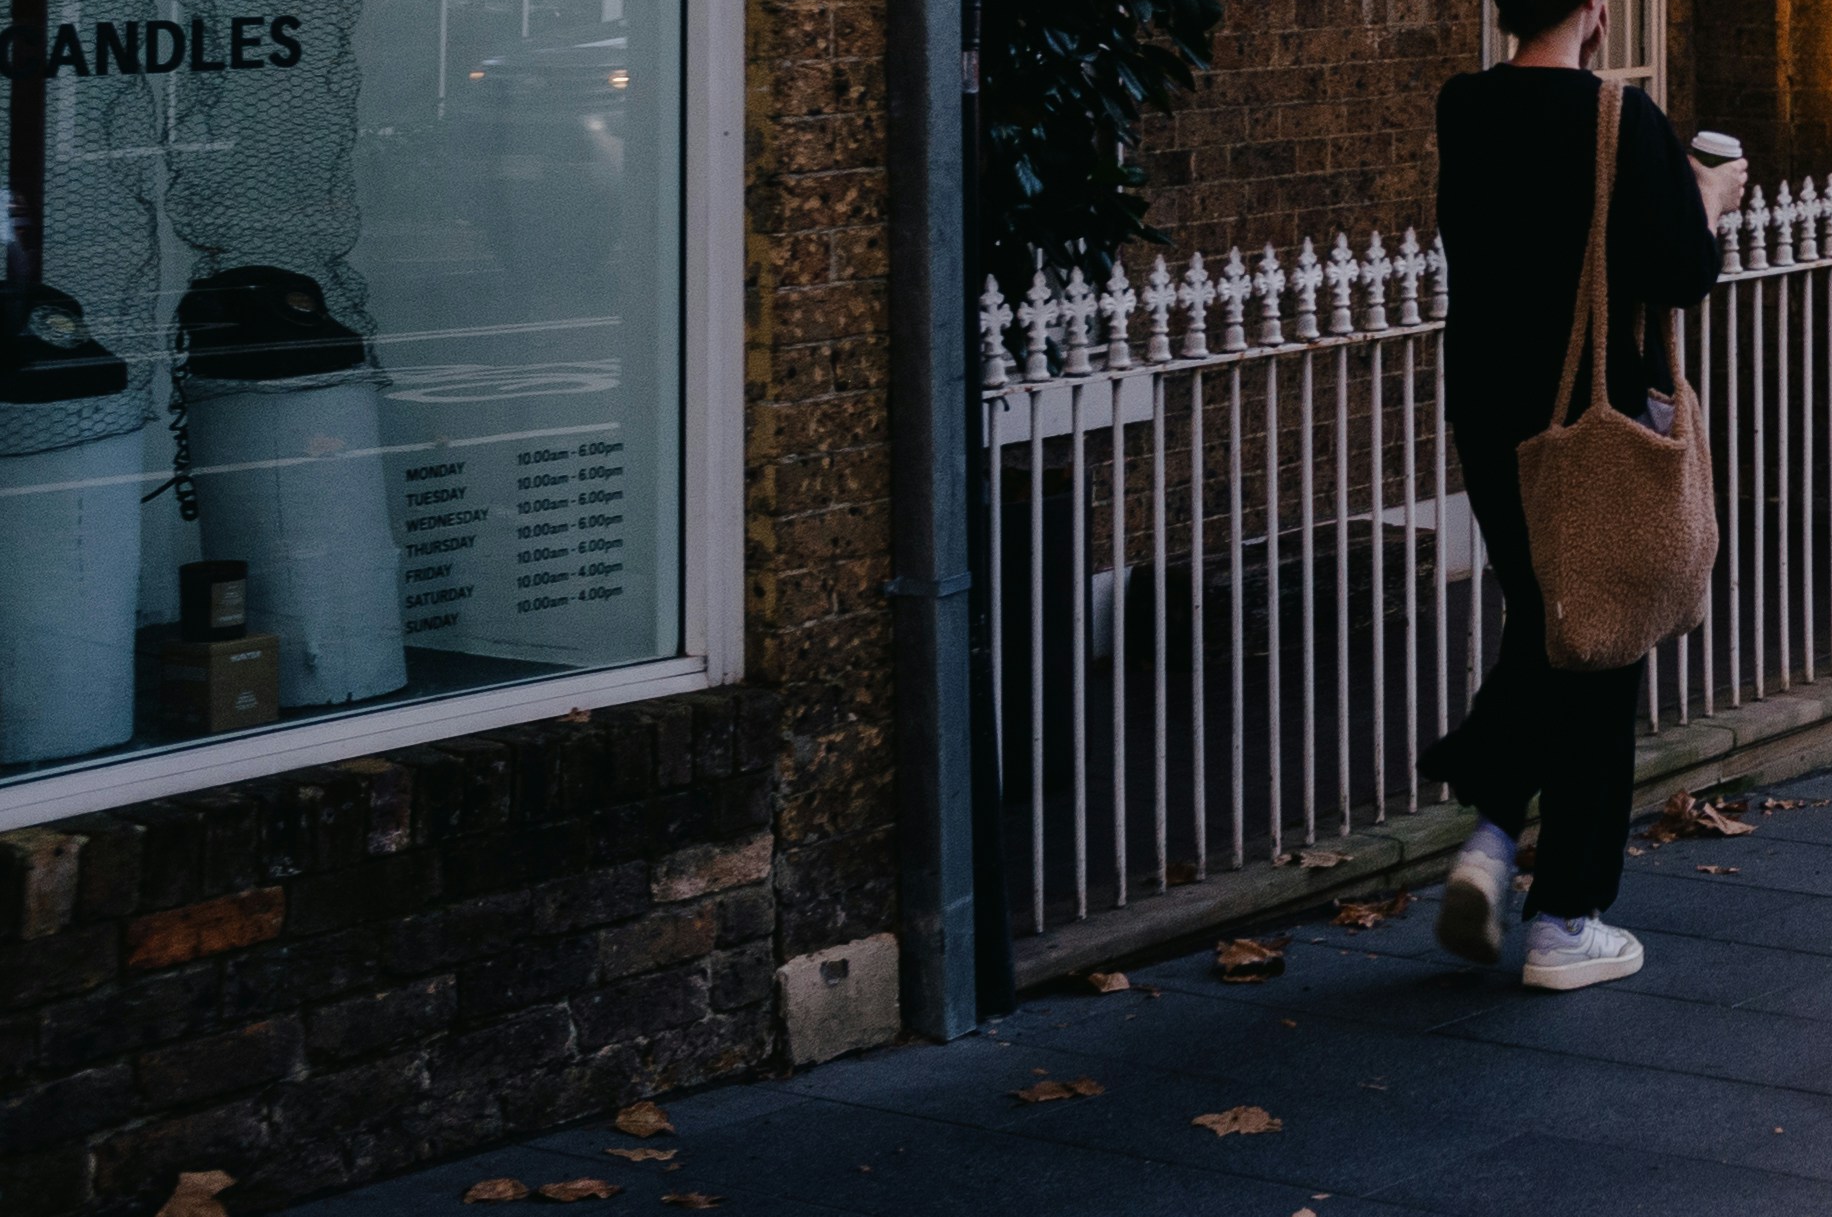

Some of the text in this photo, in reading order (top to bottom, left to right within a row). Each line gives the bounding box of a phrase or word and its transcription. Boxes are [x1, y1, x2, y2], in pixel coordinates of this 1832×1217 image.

[0, 15, 302, 80] CANDLES
[406, 462, 466, 481] MONDAY
[517, 450, 569, 465] 10.00am
[406, 486, 467, 507] TUESDAY
[517, 474, 569, 490] 10.00am
[406, 508, 489, 532] WEDNESDAY
[517, 499, 569, 515] 10.00am
[406, 535, 477, 557] THURSDAY
[517, 523, 569, 539] 10.00am
[405, 563, 453, 584] FRIDAY
[517, 547, 569, 563] 10.00am
[406, 584, 474, 609] SATURDAY
[517, 572, 569, 589] 10.00am
[405, 613, 459, 634] SUNDAY
[517, 596, 569, 613] 10.00am
